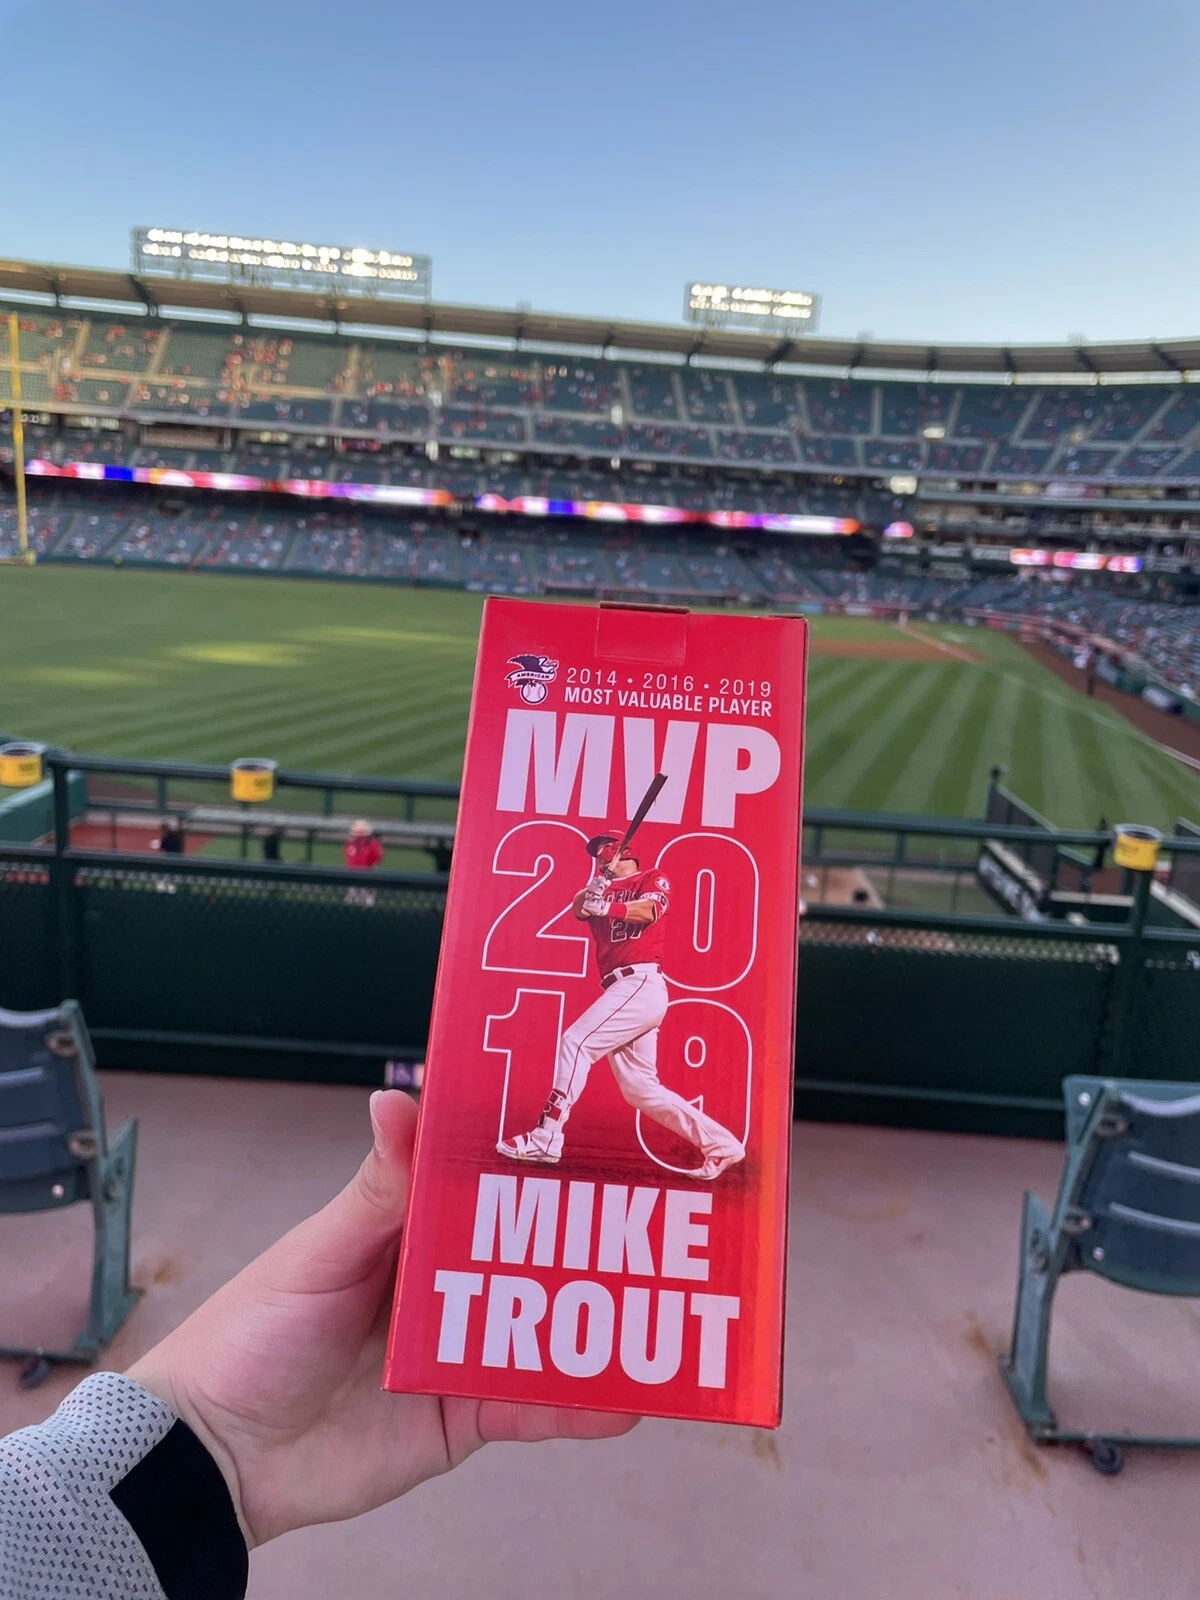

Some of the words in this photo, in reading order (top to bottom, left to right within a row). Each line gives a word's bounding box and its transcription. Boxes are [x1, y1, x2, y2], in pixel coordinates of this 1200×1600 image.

[565, 687, 613, 706] MOST
[618, 690, 703, 712] VALUABLE
[708, 697, 772, 717] PLAYER
[566, 667, 617, 686] 2014
[643, 673, 694, 692] 2016
[719, 678, 771, 697] 2019
[496, 709, 781, 828] MVP
[470, 1173, 713, 1281] MIKE
[433, 1269, 740, 1389] TROUT
